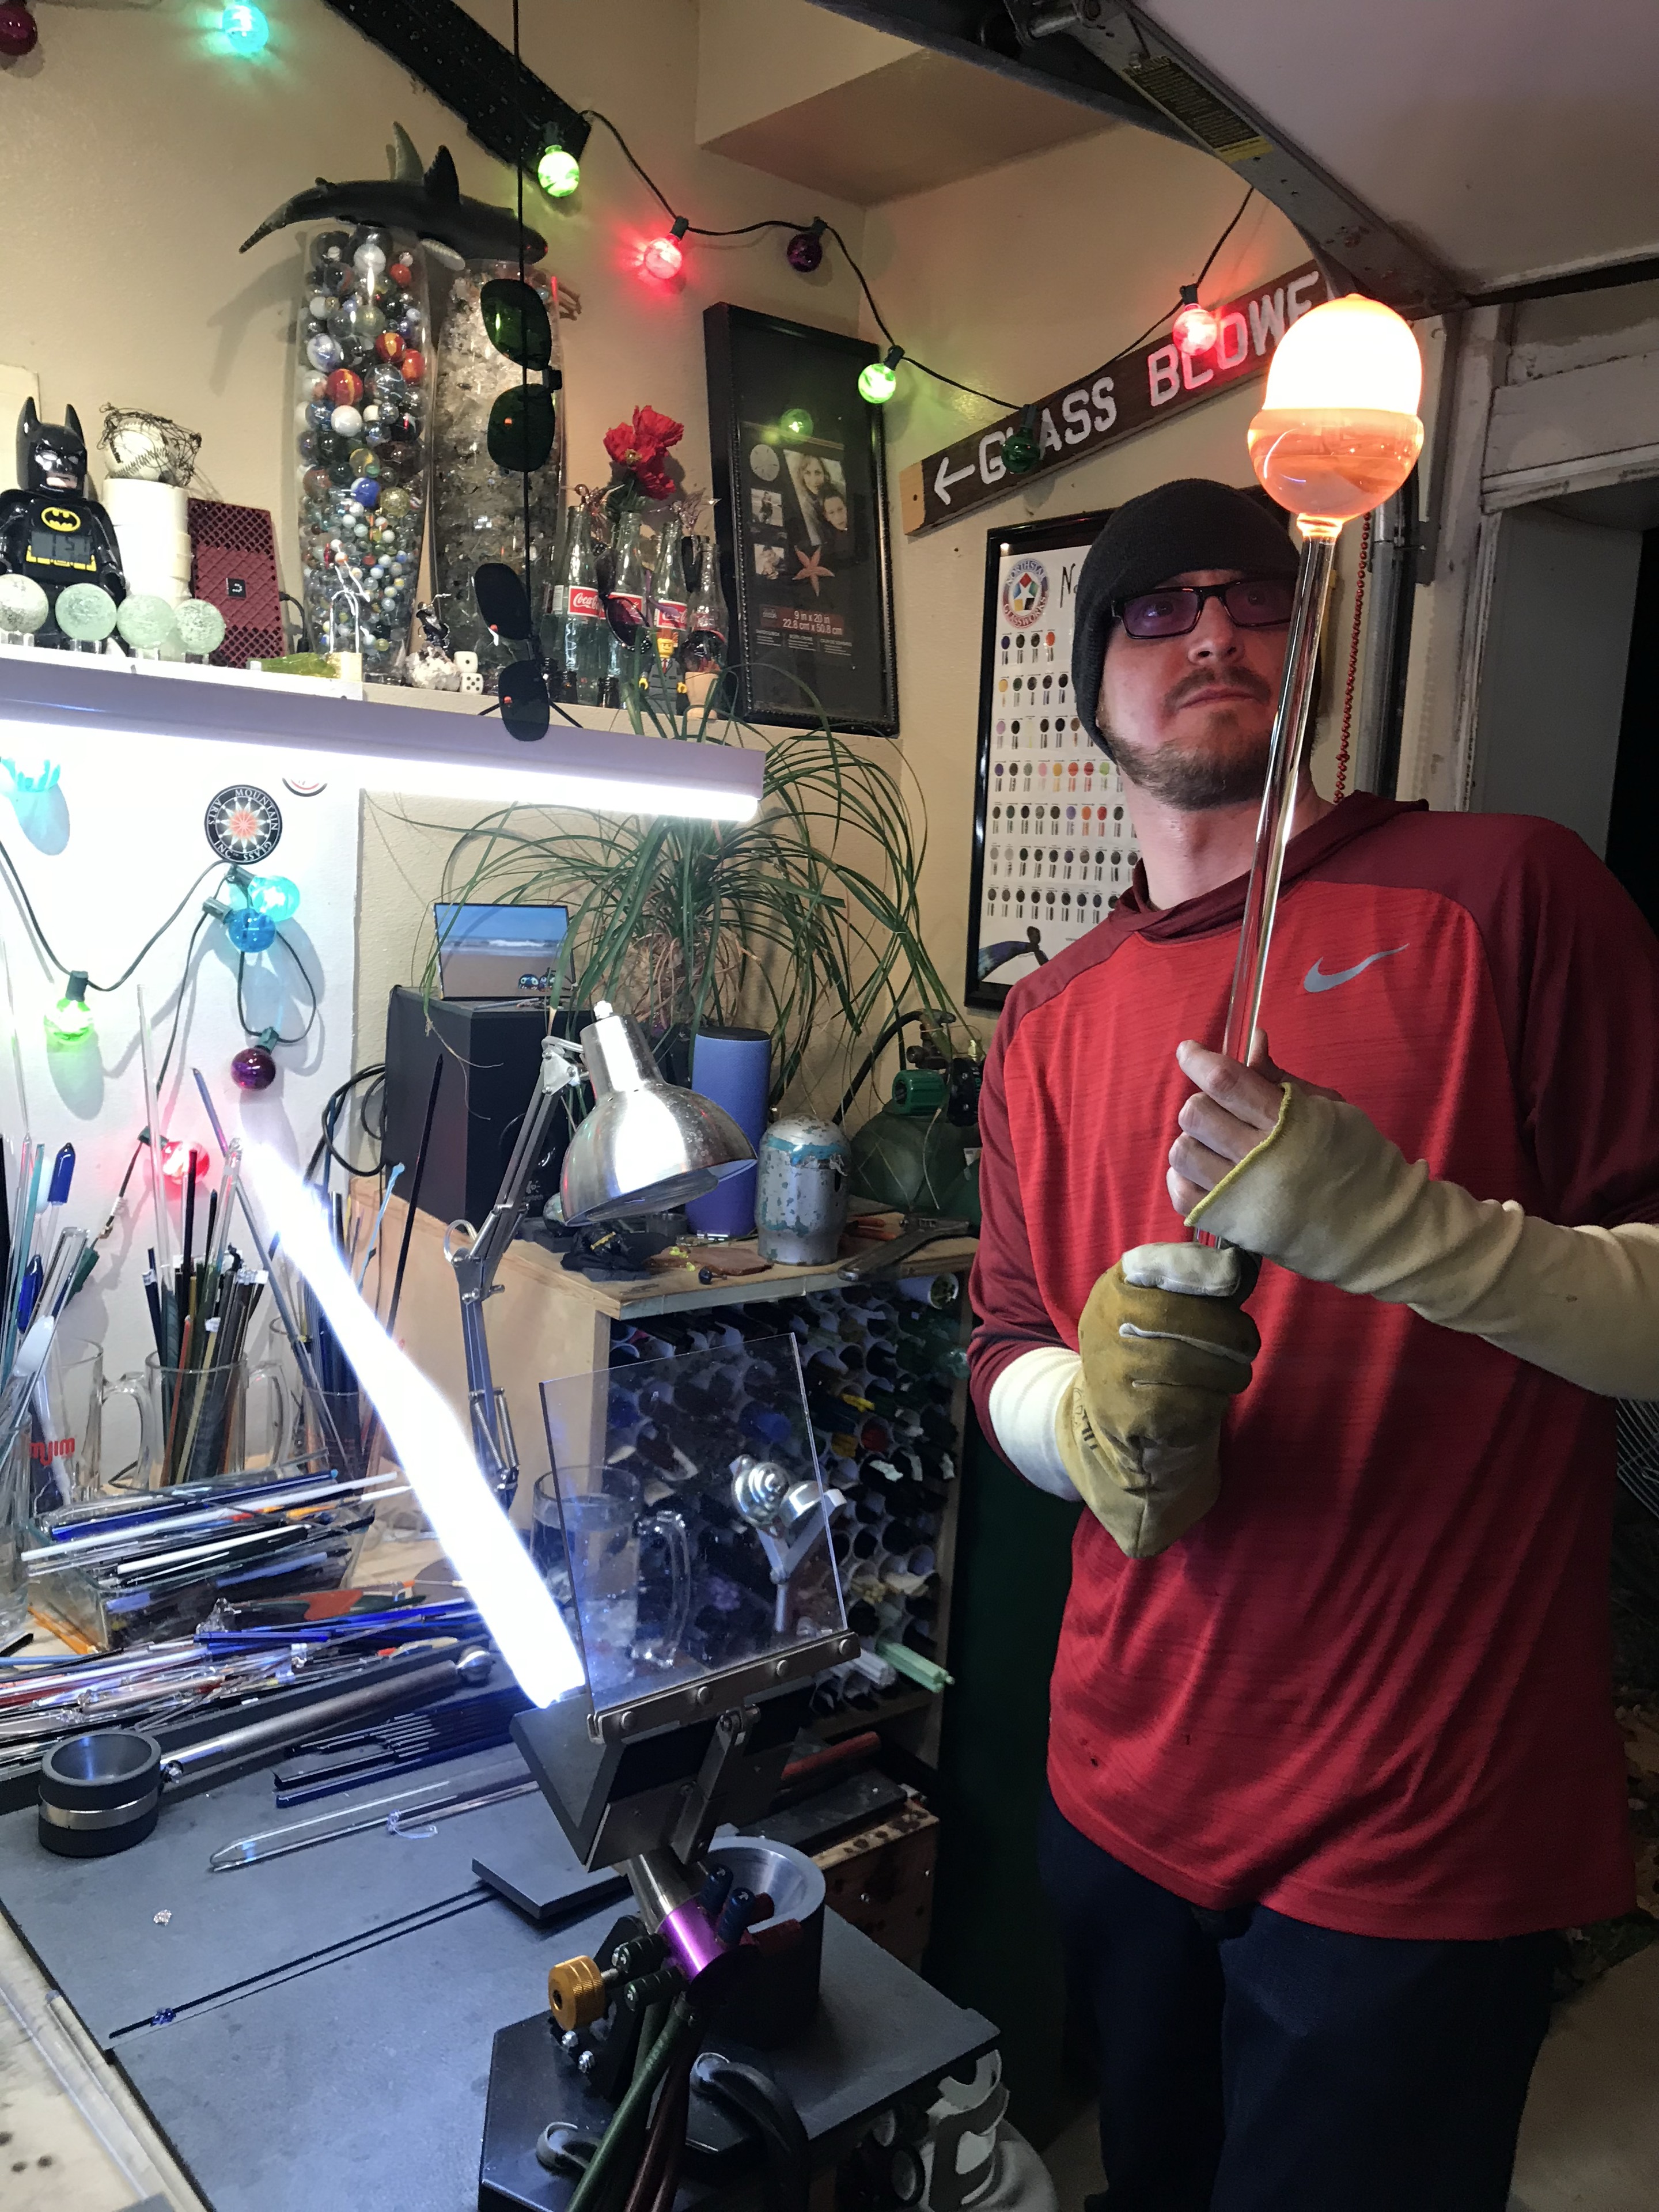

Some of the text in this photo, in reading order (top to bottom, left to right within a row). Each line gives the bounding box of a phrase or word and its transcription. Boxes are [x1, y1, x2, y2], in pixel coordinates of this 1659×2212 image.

[979, 270, 1335, 484] GASS BLOWE
[1006, 560, 1046, 585] NORTHSTAR
[794, 610, 799, 620] 9
[801, 612, 807, 620] in
[813, 613, 823, 623] 20
[824, 616, 830, 624] in
[1003, 597, 1047, 627] GLASSWORKS
[782, 618, 798, 629] 22.8
[799, 622, 809, 630] cm
[816, 623, 831, 634] 50.8
[832, 627, 842, 635] cm
[208, 798, 222, 825] ARTS
[234, 789, 278, 831] MOUNTAIN
[243, 840, 272, 862] GLASS
